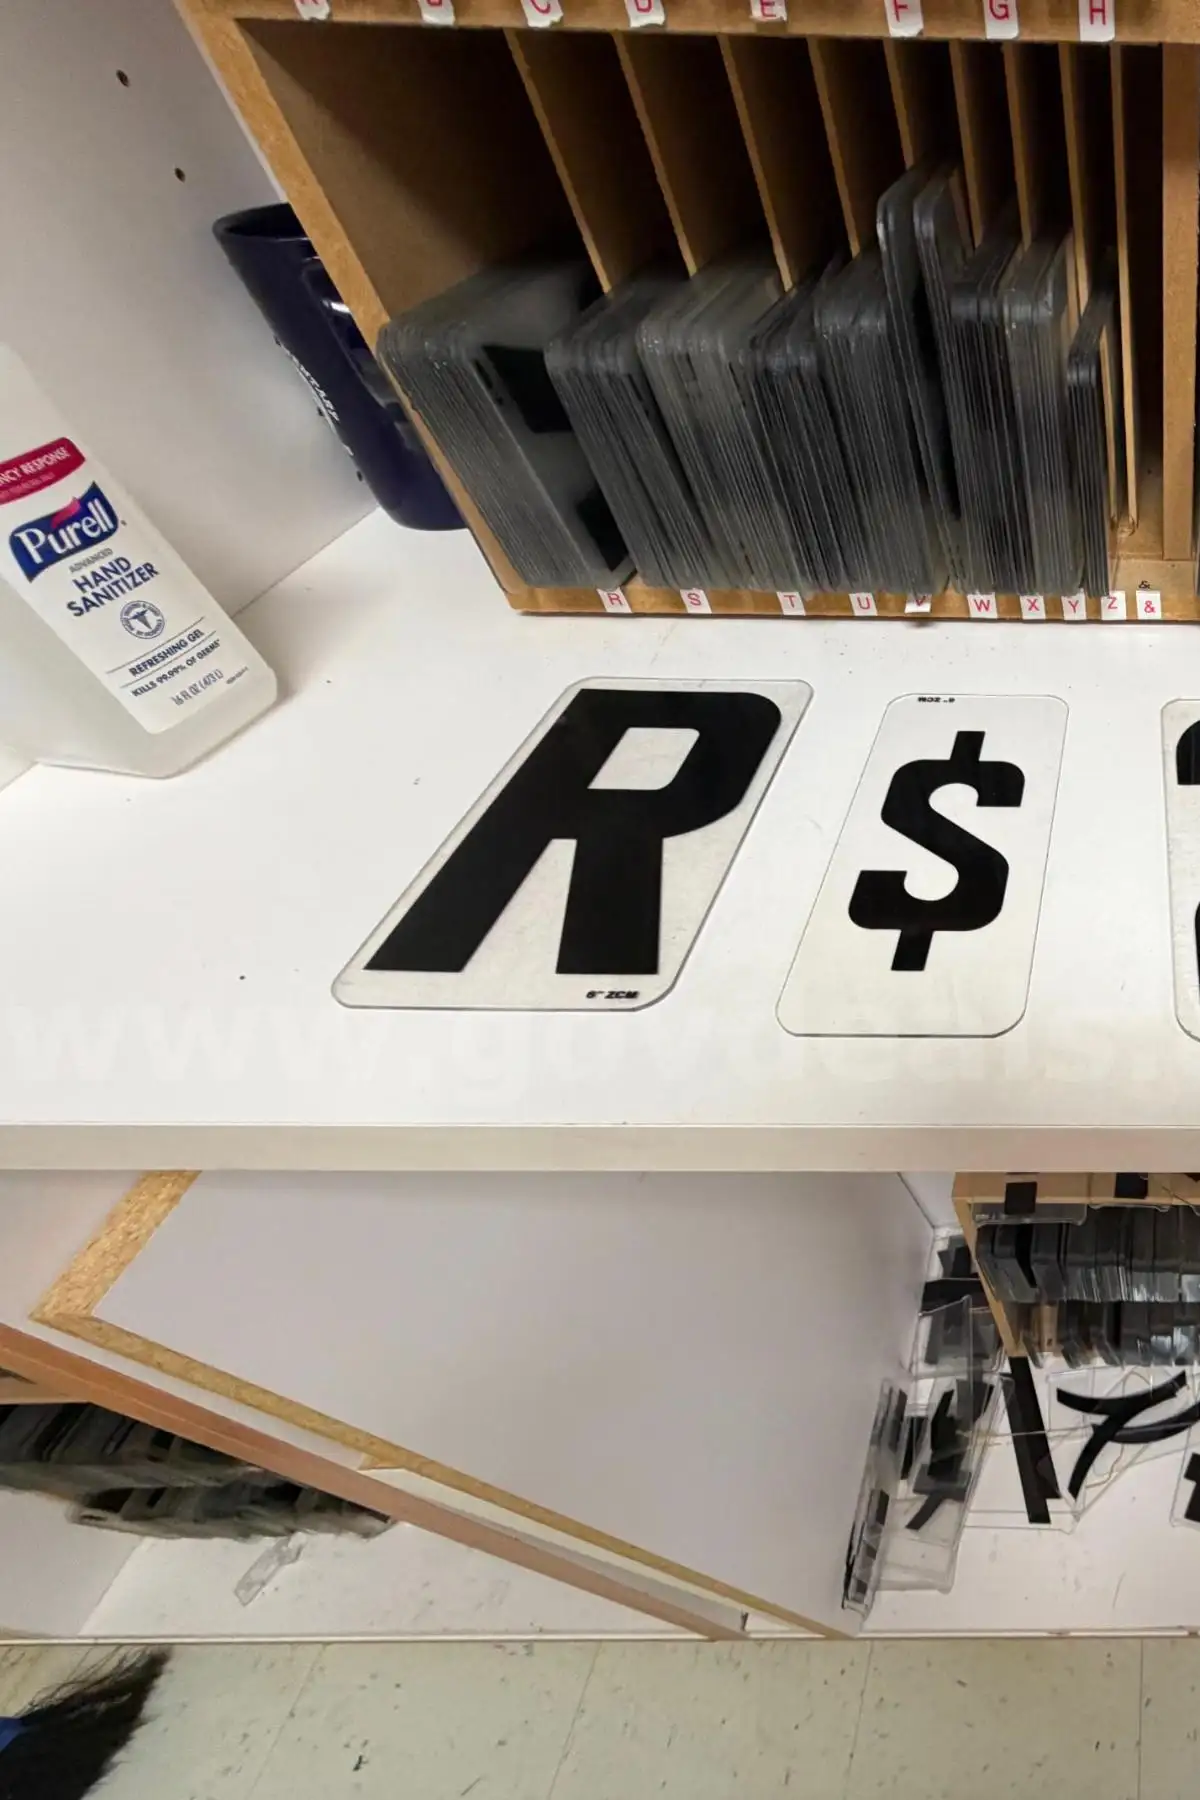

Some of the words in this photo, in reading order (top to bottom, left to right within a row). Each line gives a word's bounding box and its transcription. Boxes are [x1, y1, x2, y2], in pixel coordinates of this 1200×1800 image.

[988, 0, 1011, 21] G
[1089, 0, 1107, 26] H
[14, 498, 115, 565] Purell
[68, 548, 114, 573] ADVANCED
[73, 556, 132, 594] HAND
[66, 562, 160, 618] SANITIZER
[607, 593, 622, 606] R
[687, 593, 701, 606] S
[784, 594, 797, 609] T
[857, 597, 871, 611] U
[974, 599, 991, 613] W
[1028, 598, 1040, 612] X
[1068, 600, 1079, 614] Y
[1107, 596, 1118, 610] Z
[1144, 600, 1156, 614] &
[128, 637, 189, 677] REFRESHING
[131, 680, 158, 698] KILLS
[185, 655, 198, 667] OF
[364, 688, 782, 974] R
[848, 730, 1025, 972] $
[604, 989, 640, 1000] ZCM
